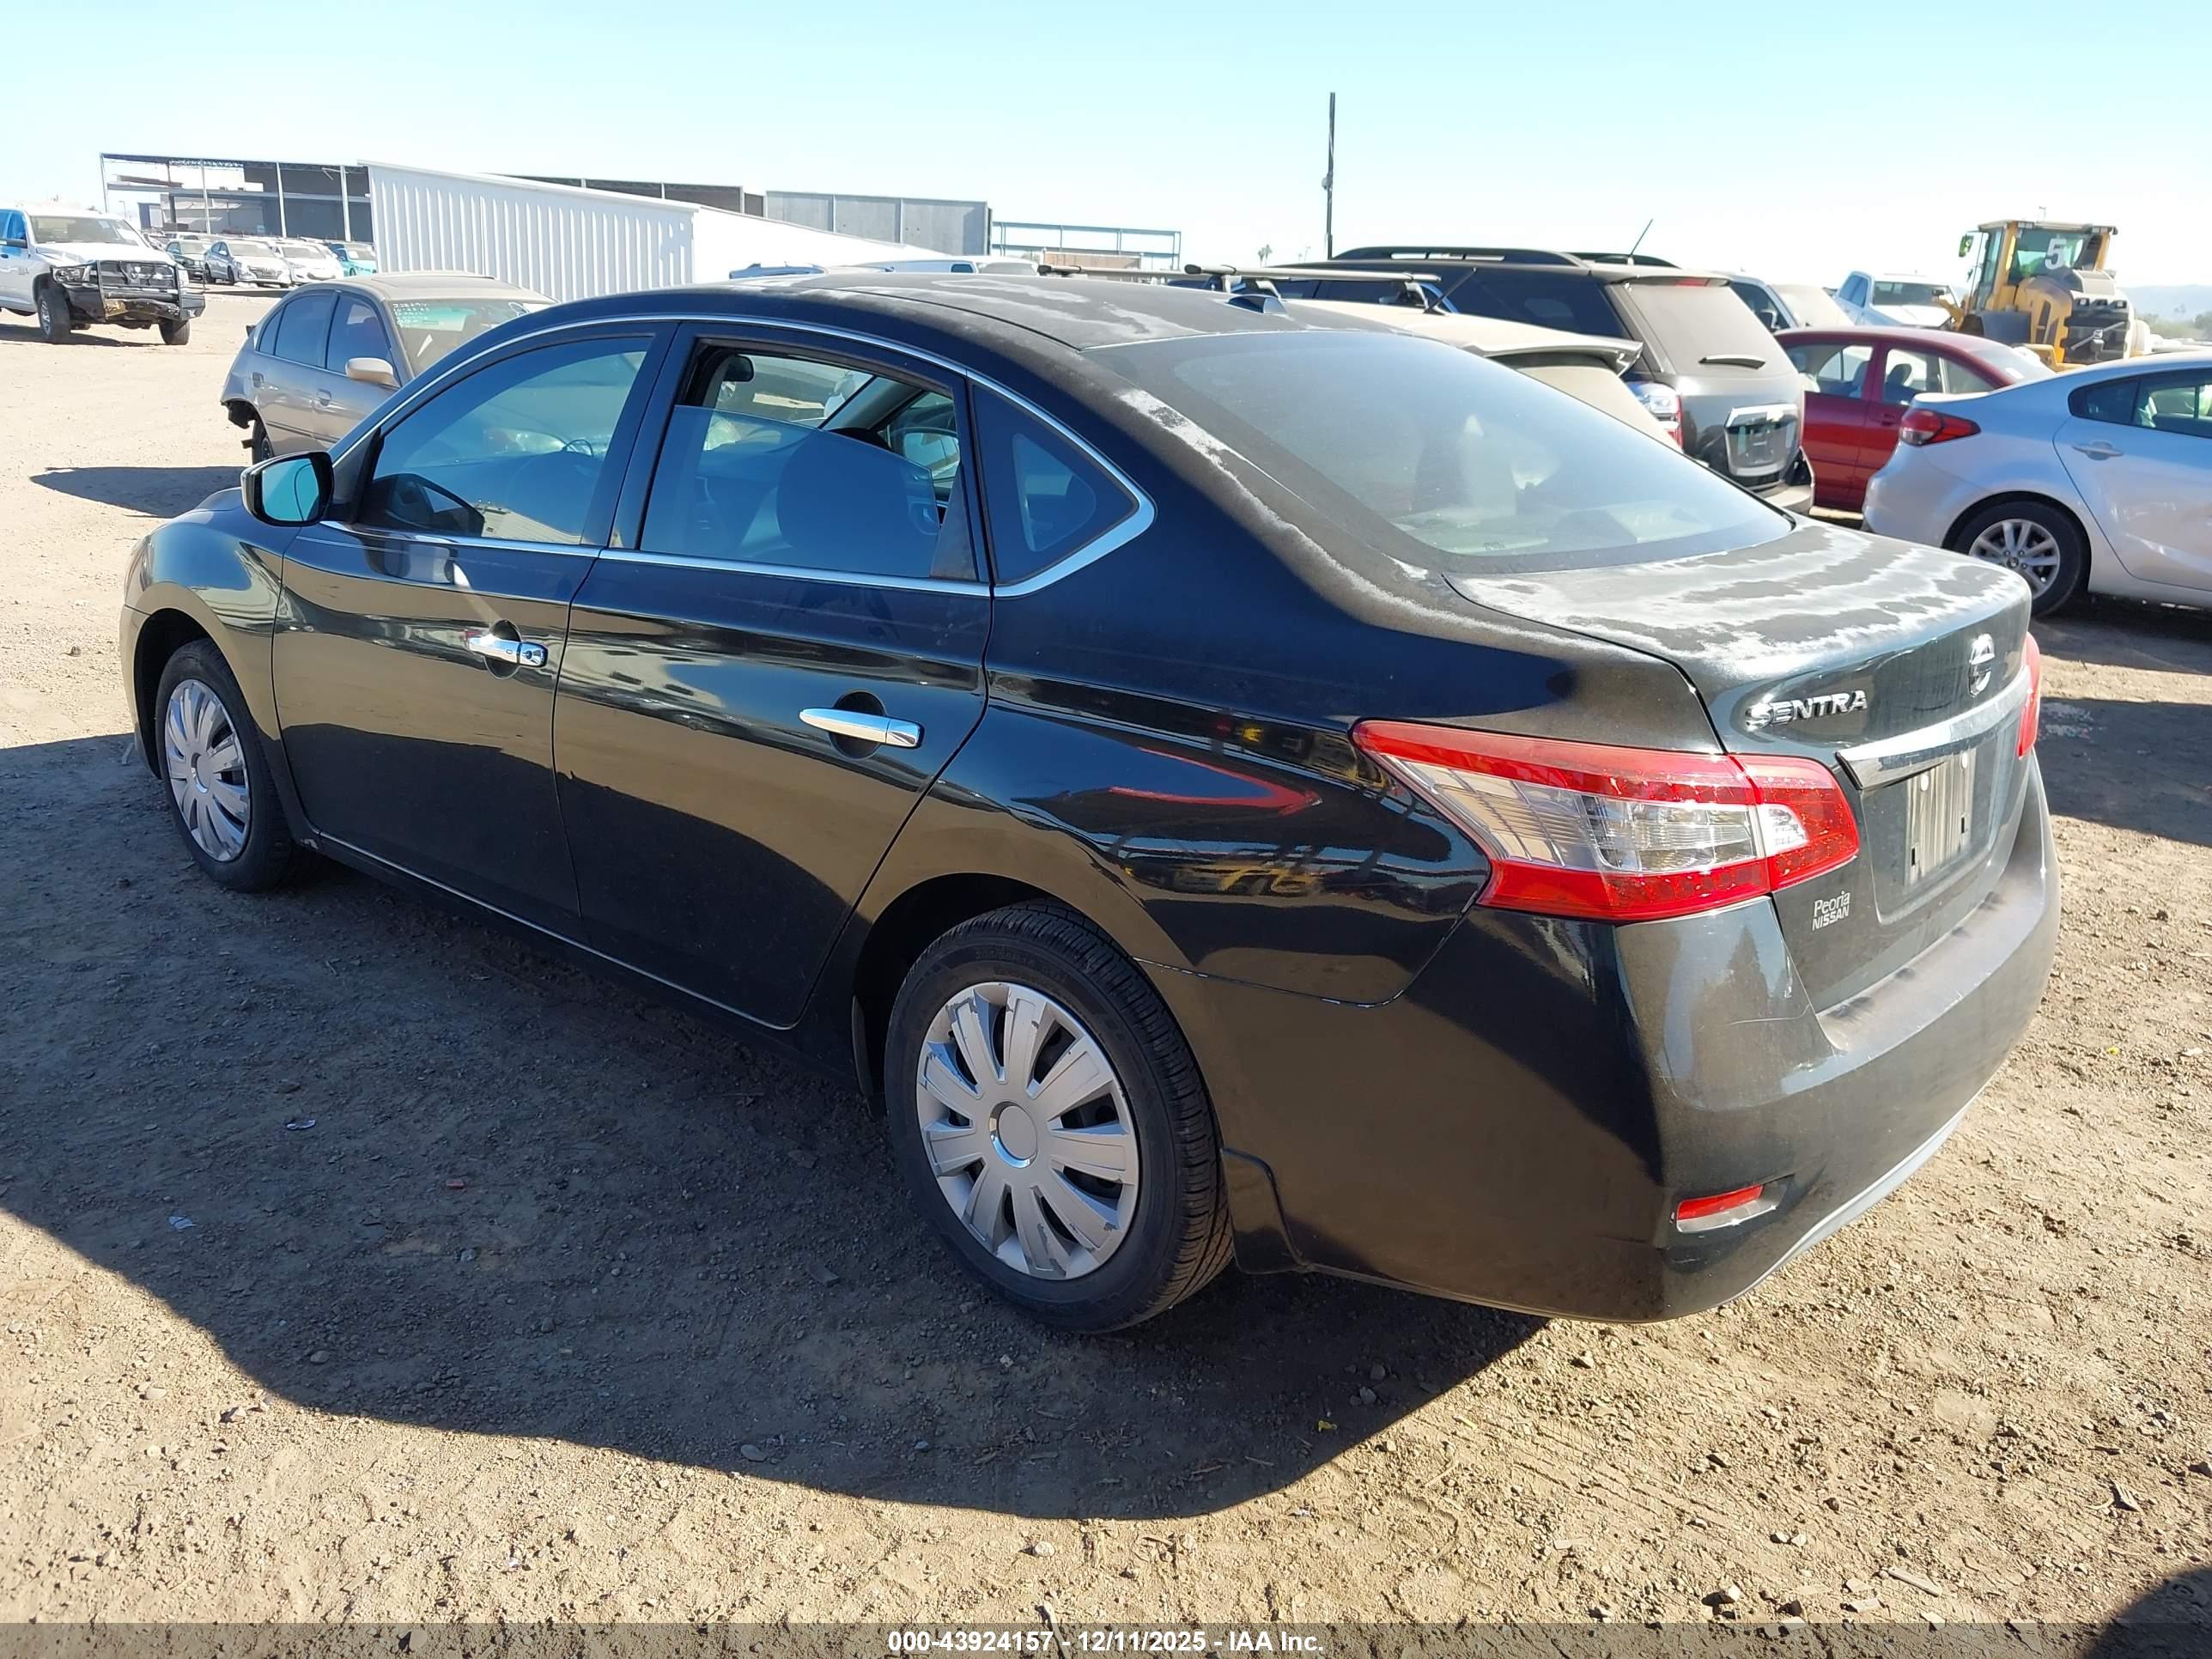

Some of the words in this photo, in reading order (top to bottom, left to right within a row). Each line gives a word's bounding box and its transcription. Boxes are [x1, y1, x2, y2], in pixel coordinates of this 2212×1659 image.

[2045, 238, 2067, 270] 5
[1745, 690, 1869, 730] SENTRA
[1812, 904, 1850, 932] NISSAN
[1814, 890, 1850, 917] Peoria
